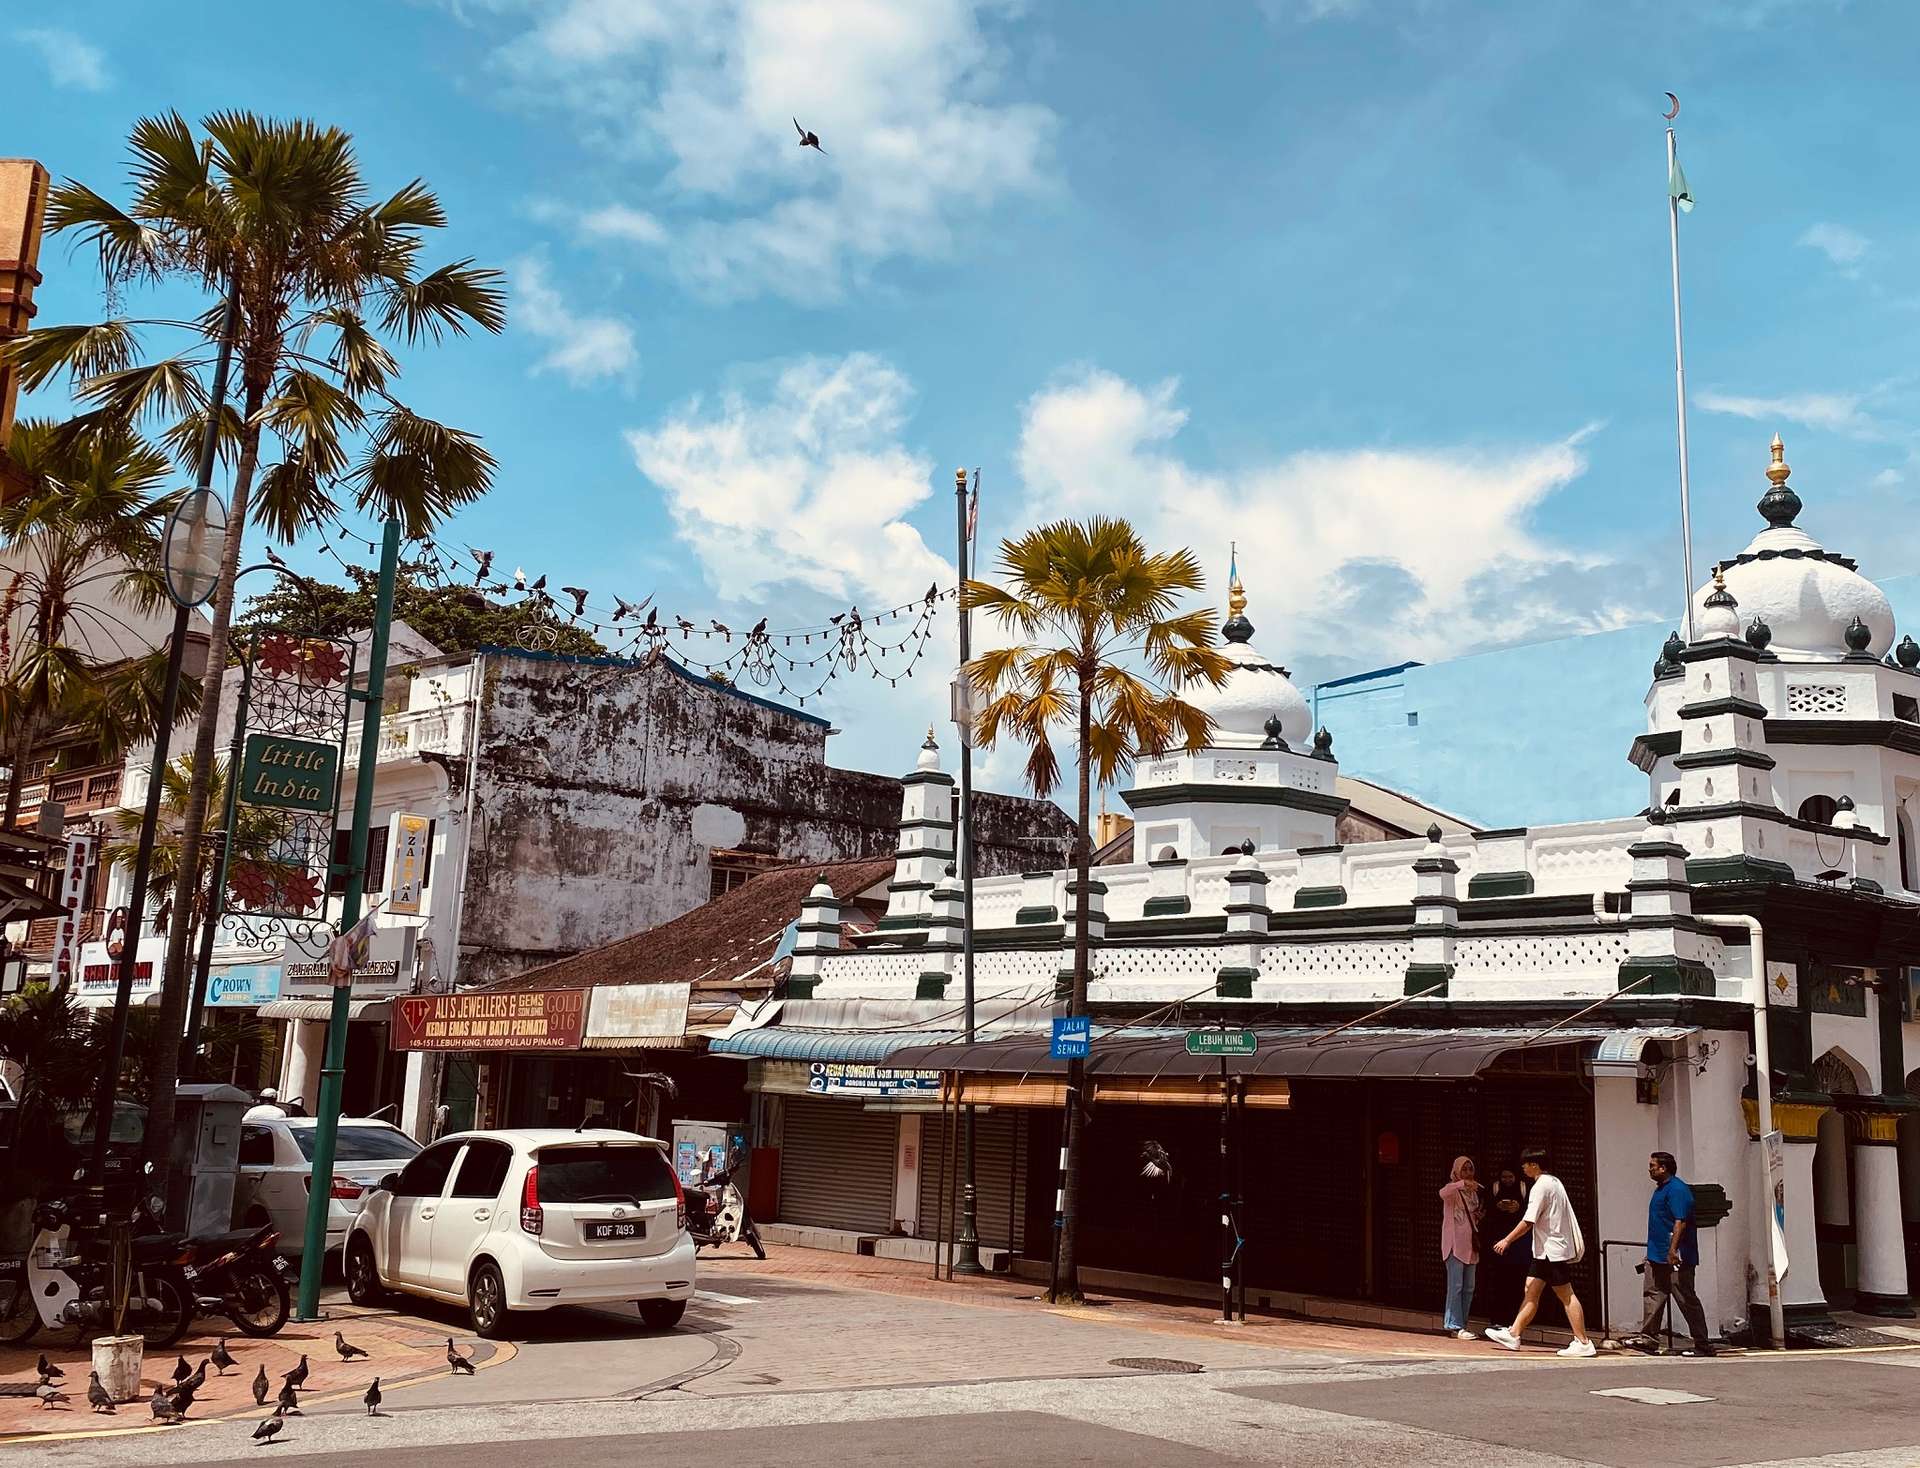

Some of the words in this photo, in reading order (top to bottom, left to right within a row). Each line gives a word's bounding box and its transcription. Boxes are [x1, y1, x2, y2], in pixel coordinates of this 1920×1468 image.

[260, 744, 325, 770] Little
[253, 772, 321, 800] India
[69, 842, 85, 892] BHAI
[57, 896, 79, 973] BIRYAN
[211, 977, 251, 1002] CROWN
[458, 996, 507, 1018] JEWELLERS
[509, 995, 517, 1017] &
[518, 994, 545, 1008] GEMS
[546, 994, 582, 1013] GOLD
[426, 1021, 447, 1037] KEDAI
[449, 1021, 470, 1037] EMAS
[471, 1020, 487, 1036] DAN
[489, 1020, 510, 1036] BATU
[511, 1019, 548, 1036] PERMATA
[551, 1012, 575, 1031] 916
[1061, 1021, 1085, 1031] JALAN
[436, 1039, 461, 1047] LEBUH
[504, 1038, 531, 1046] PULAU
[532, 1037, 564, 1046] PINANG
[1199, 1035, 1223, 1045] LEBUH
[1224, 1035, 1243, 1046] KING
[596, 1225, 613, 1237] KDF
[615, 1224, 635, 1236] 7493
